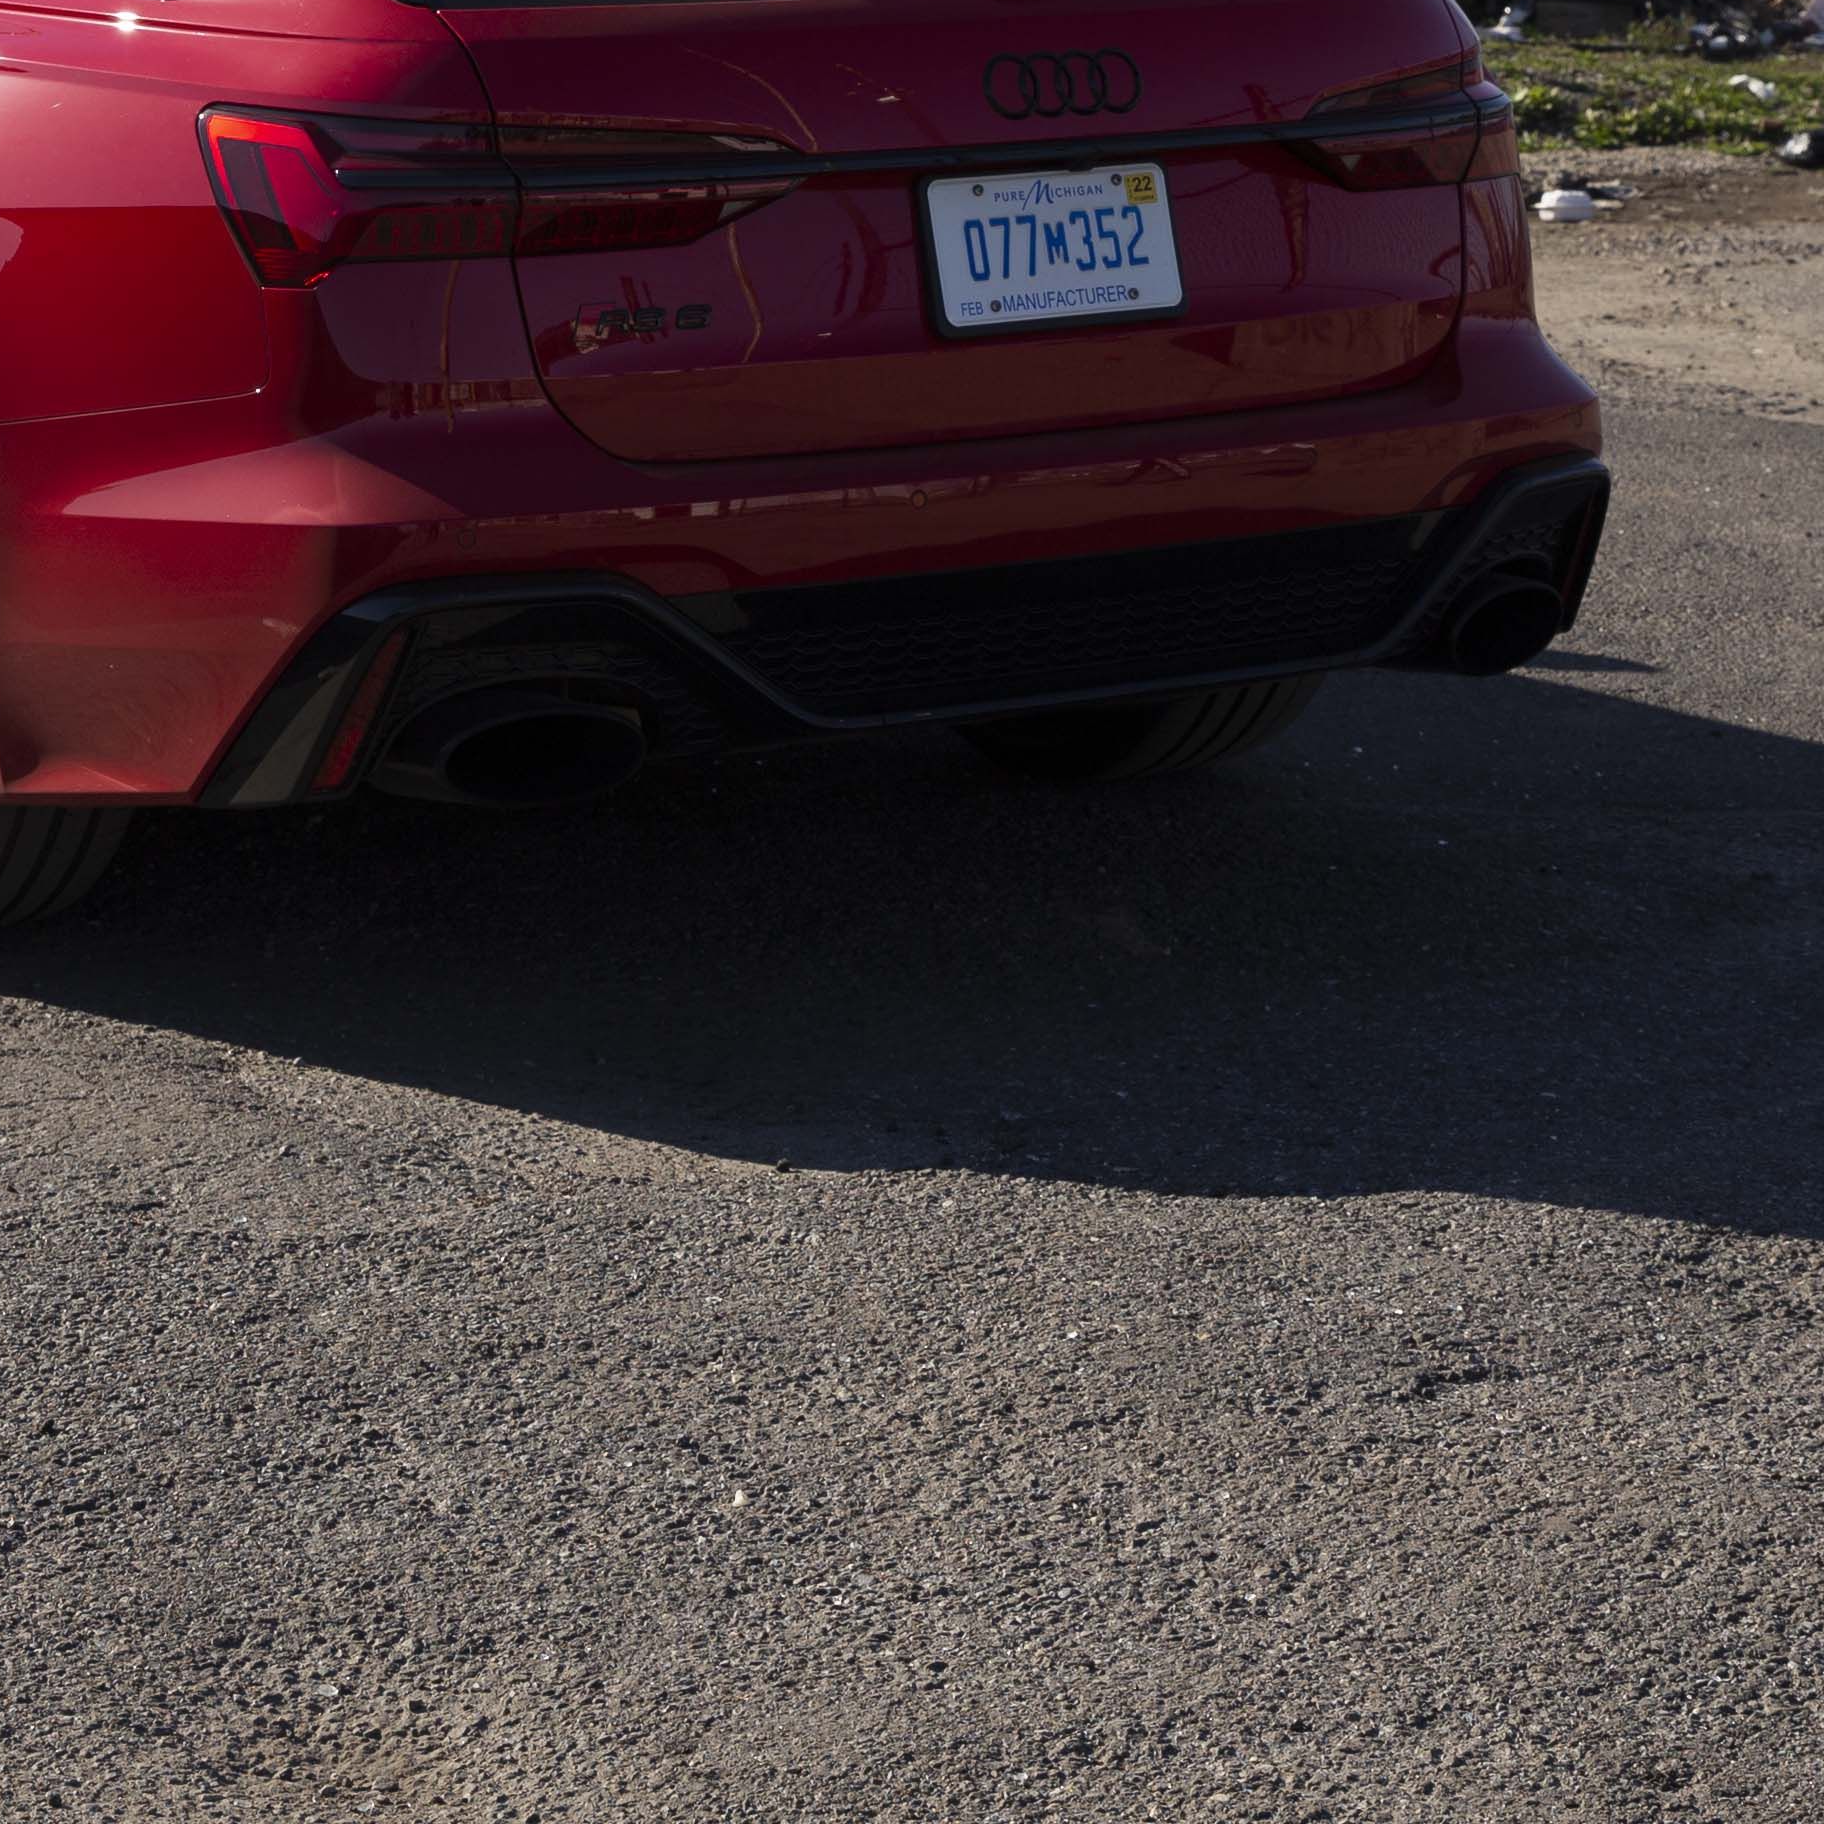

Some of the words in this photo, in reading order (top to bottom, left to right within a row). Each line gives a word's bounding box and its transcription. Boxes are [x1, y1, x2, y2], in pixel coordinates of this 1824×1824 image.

[993, 190, 1026, 203] PURE
[1022, 179, 1104, 211] MICHIGAN
[1132, 175, 1153, 193] 22
[963, 205, 1150, 282] 077M352
[960, 302, 984, 317] FEB
[1002, 285, 1129, 314] MANUFACTURER
